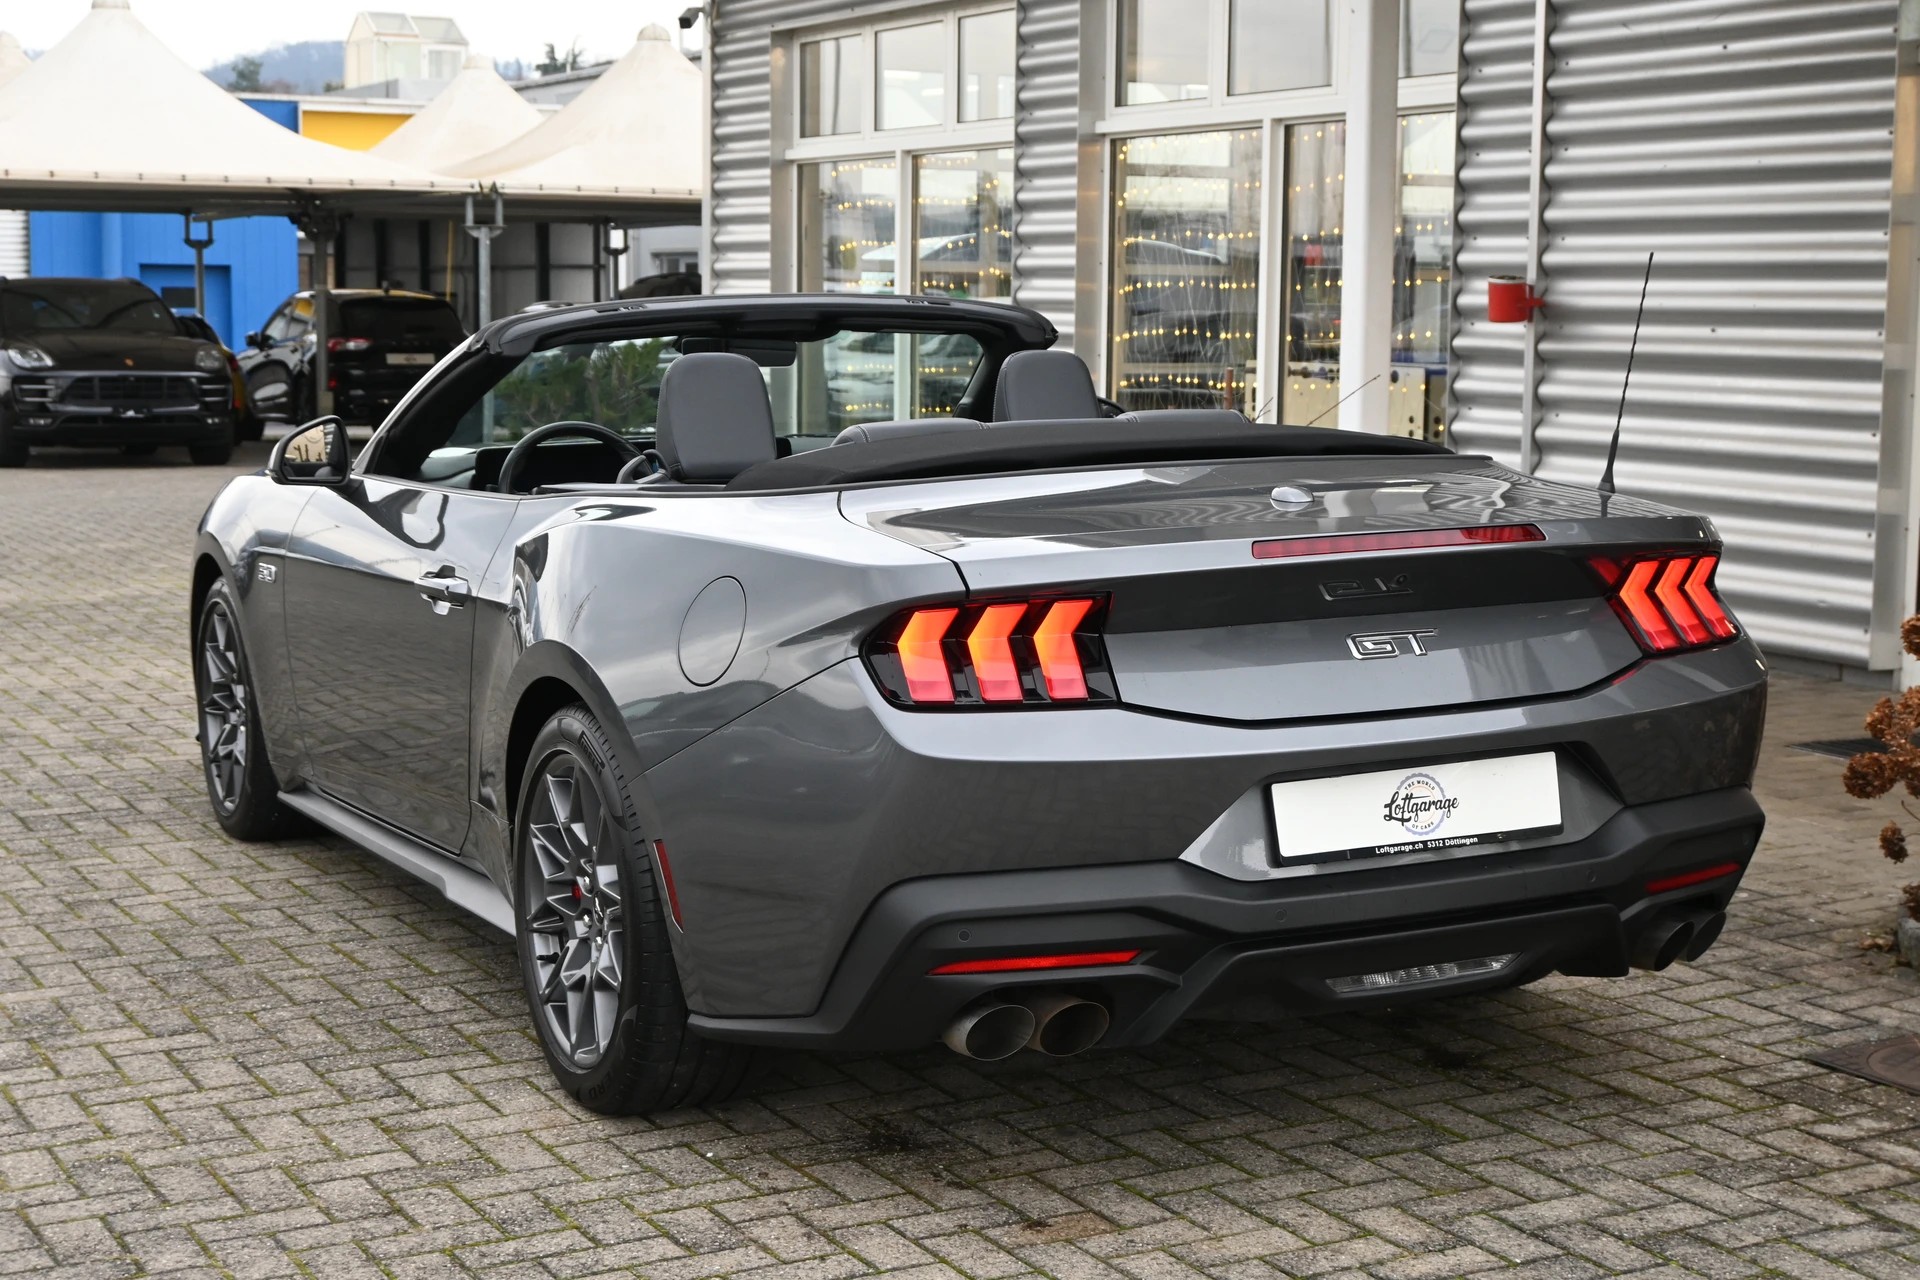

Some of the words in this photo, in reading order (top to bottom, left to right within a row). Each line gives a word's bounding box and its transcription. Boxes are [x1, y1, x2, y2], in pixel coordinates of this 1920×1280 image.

[1345, 628, 1438, 660] GT
[1404, 781, 1415, 791] THE
[1416, 780, 1436, 791] WORLD
[1383, 791, 1460, 827] Loftgarage
[1375, 842, 1424, 854] Loftgarage.ch
[1427, 840, 1444, 849] 5312
[1445, 837, 1478, 847] Döttingen
